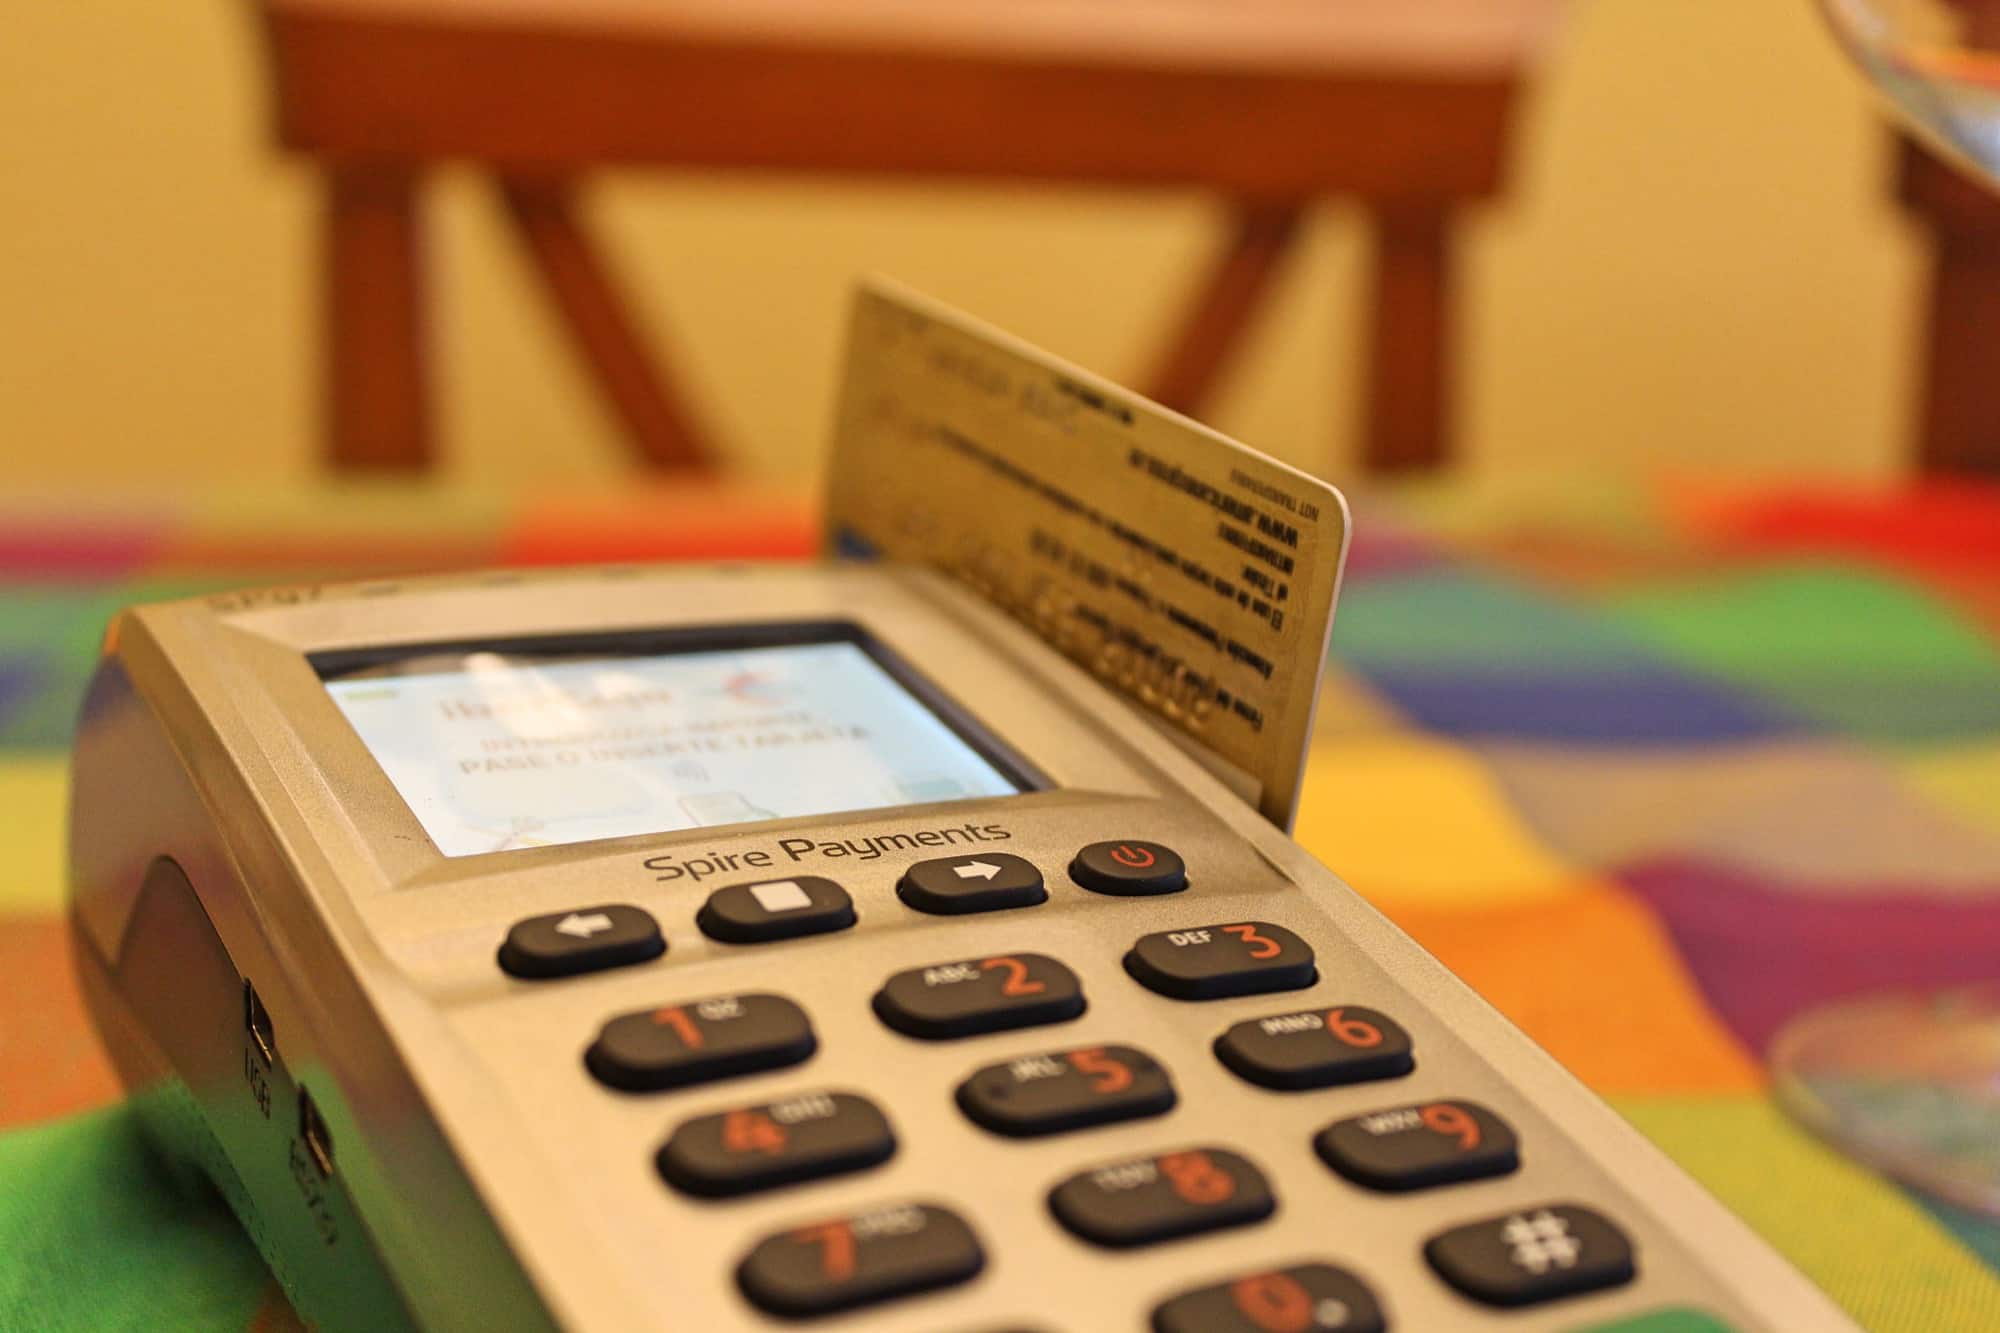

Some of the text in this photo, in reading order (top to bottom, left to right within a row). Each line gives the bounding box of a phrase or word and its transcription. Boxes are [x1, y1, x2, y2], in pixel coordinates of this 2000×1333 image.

[643, 824, 1011, 882] Spire Payments
[1168, 924, 1282, 961] DEF 3
[923, 957, 1047, 997] ABC 2
[651, 1006, 704, 1050] 1
[1326, 1009, 1383, 1049] 6
[1067, 1047, 1133, 1093] 5
[722, 1110, 788, 1154] 4
[1420, 1102, 1481, 1151] 9
[1157, 1150, 1236, 1205] 8
[794, 1217, 857, 1281] 7
